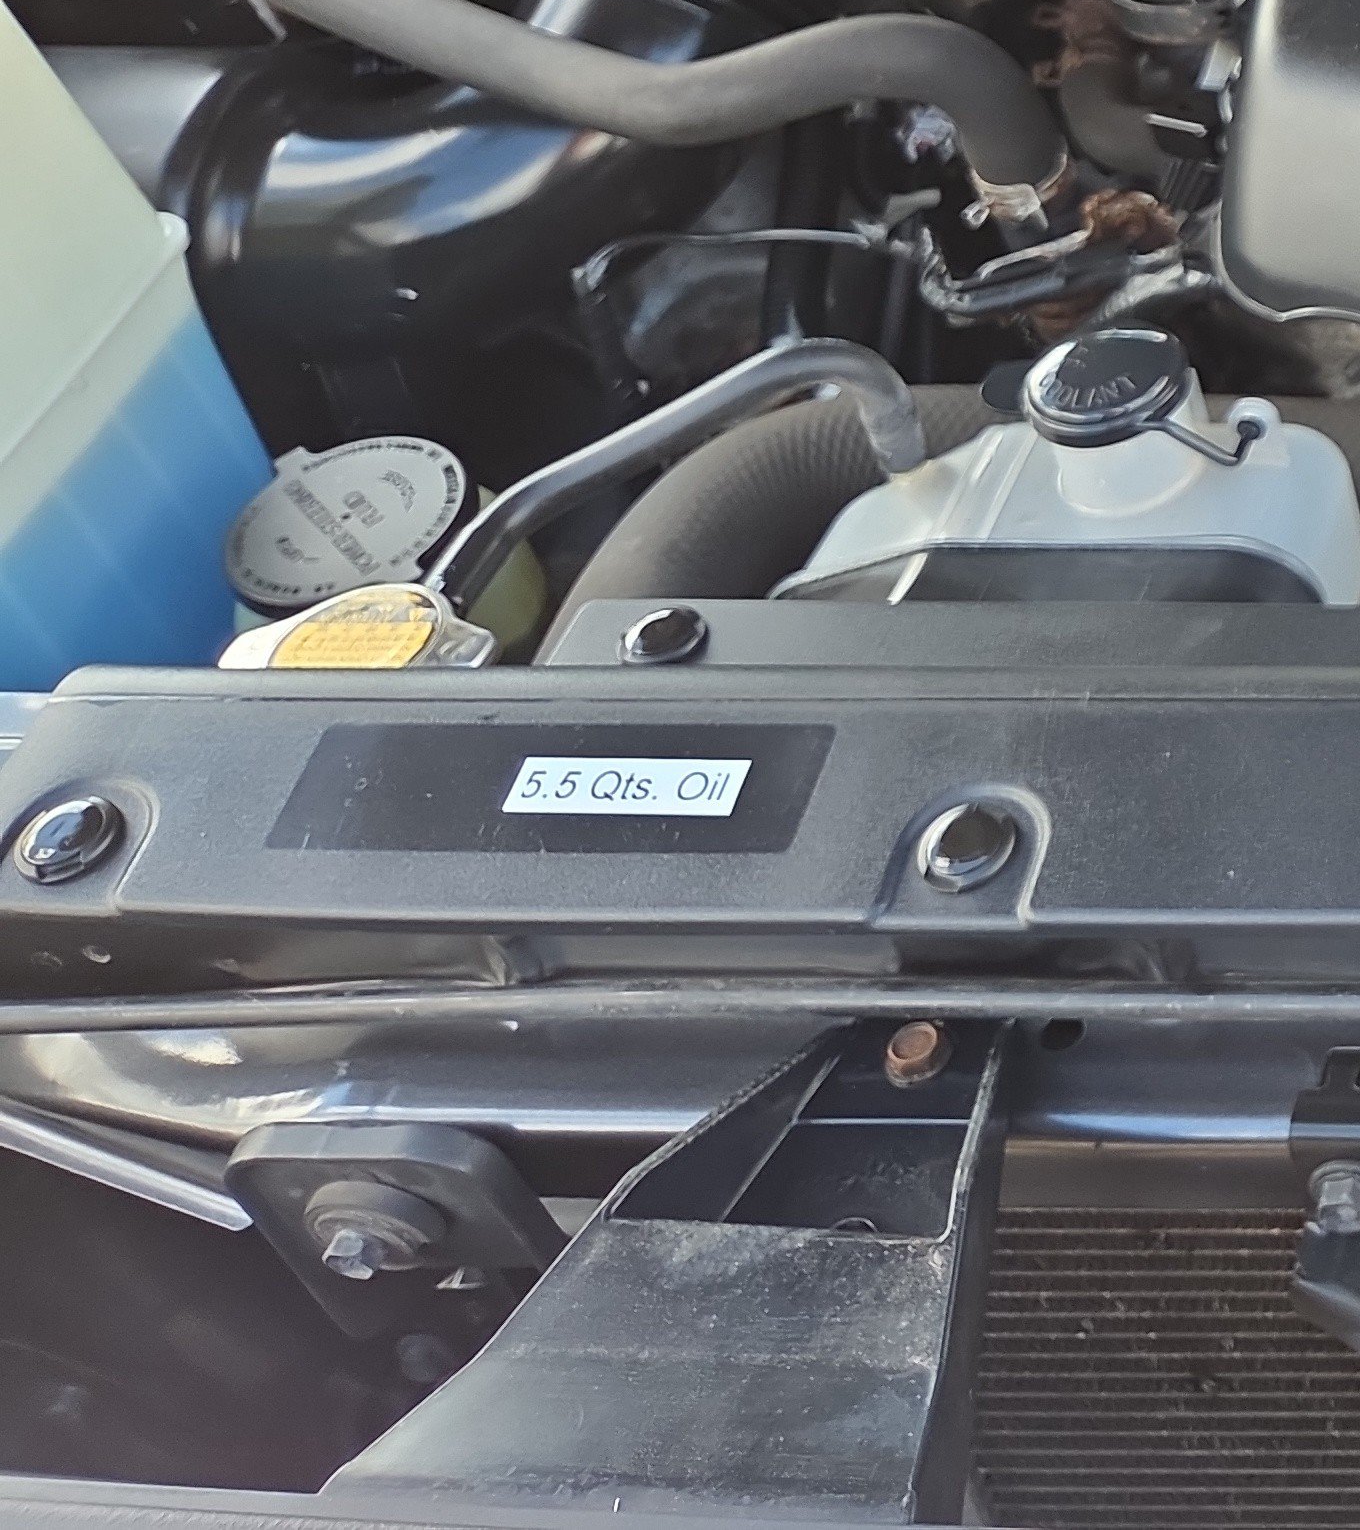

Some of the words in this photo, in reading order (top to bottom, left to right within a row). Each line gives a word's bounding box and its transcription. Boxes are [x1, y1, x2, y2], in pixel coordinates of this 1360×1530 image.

[521, 770, 582, 799] 5.5
[590, 770, 658, 801] Qts.
[677, 771, 730, 801] Oil
